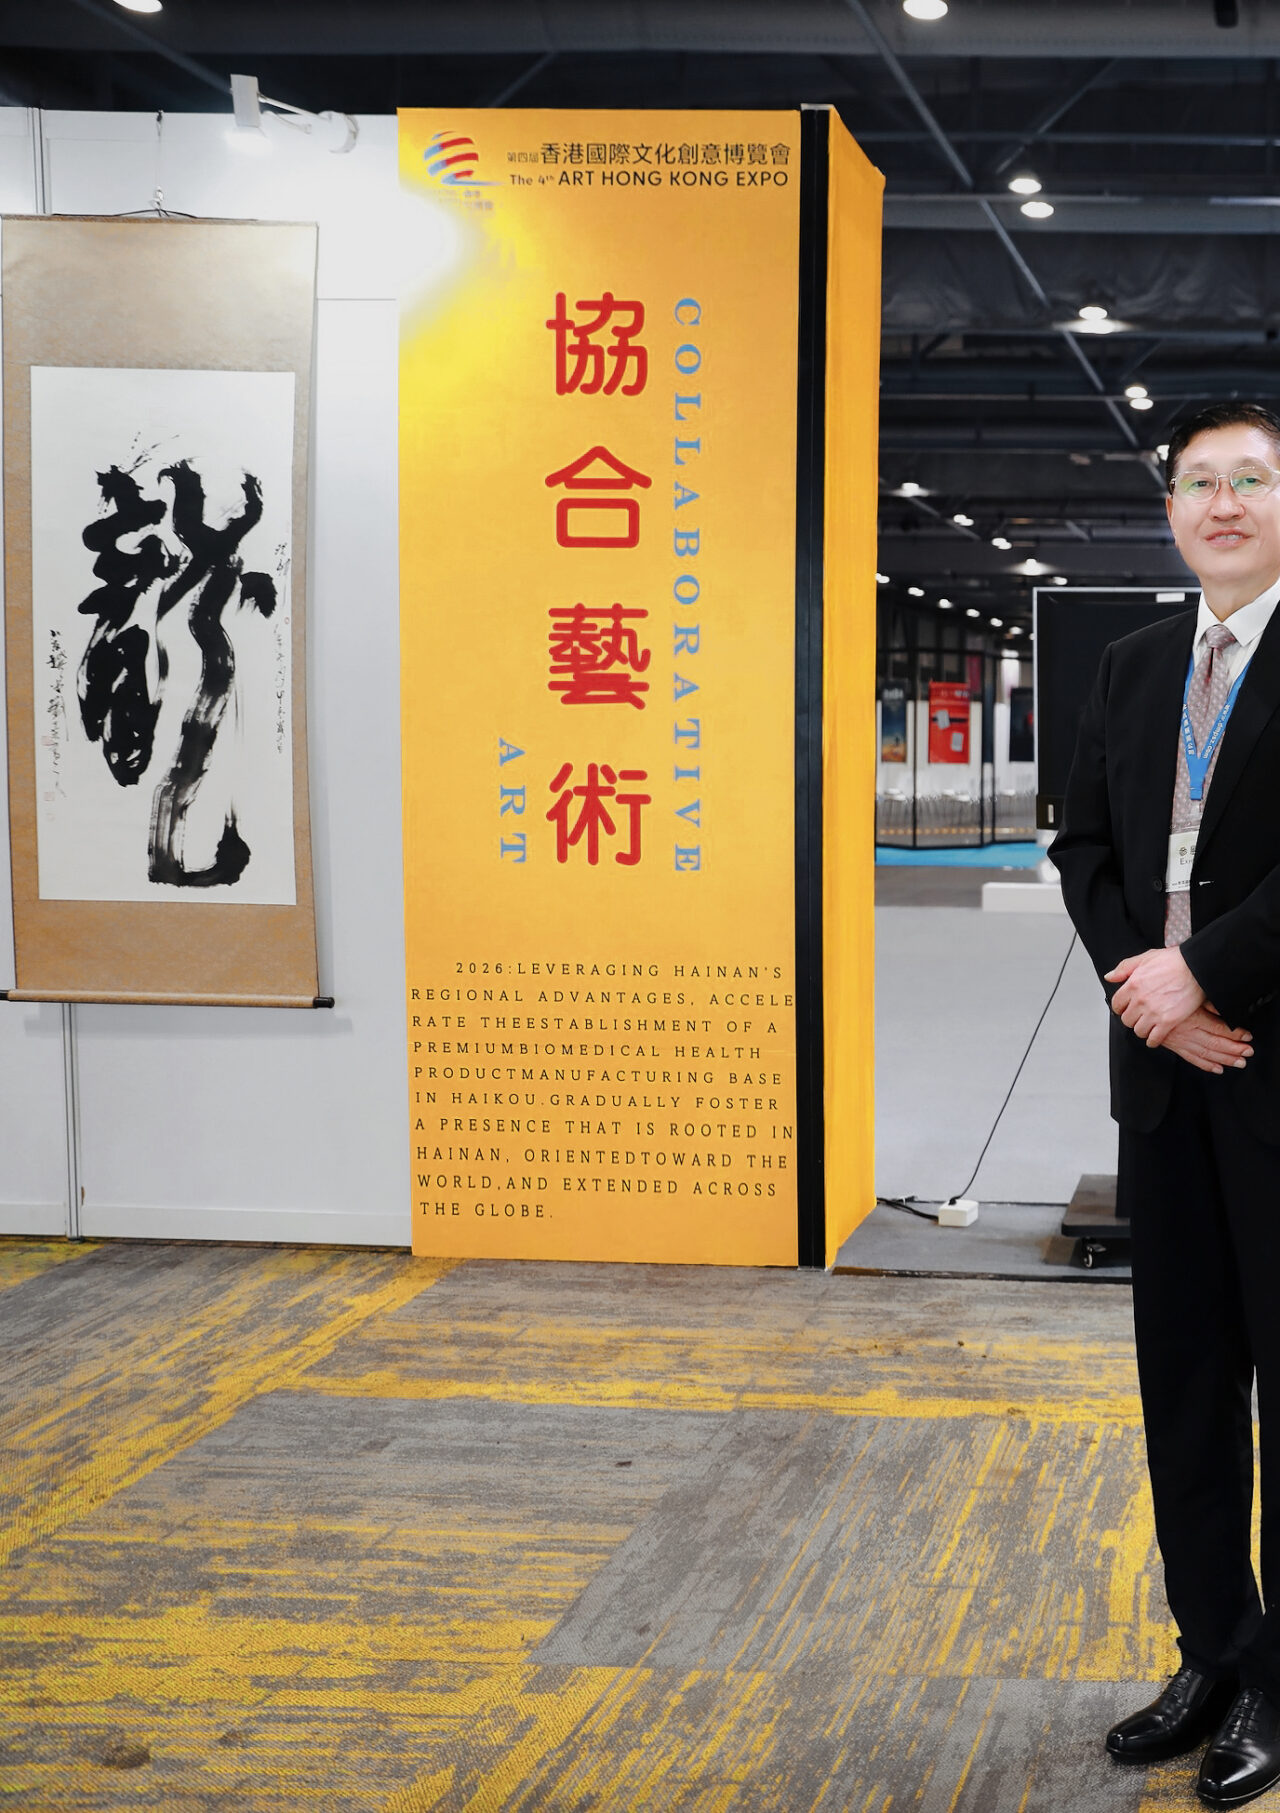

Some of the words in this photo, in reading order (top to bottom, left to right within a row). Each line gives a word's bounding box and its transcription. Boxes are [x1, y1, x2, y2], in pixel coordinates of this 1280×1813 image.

[510, 174, 533, 186] The
[558, 170, 594, 186] ART
[602, 170, 662, 187] HONG
[670, 171, 729, 187] KONG
[736, 171, 788, 187] EXPO
[545, 291, 652, 866] 協合藝術
[674, 297, 702, 872] COLLABORATIVE
[499, 737, 527, 864] ART
[674, 965, 782, 980] HAINAN'S
[411, 989, 524, 1002] REGIONAL
[710, 993, 794, 1007] ACCELE
[412, 1016, 466, 1028] RATE
[726, 1021, 753, 1033] OF
[766, 1022, 777, 1034] A
[674, 1046, 760, 1060] HEALTH
[729, 1073, 782, 1085] BASE
[415, 1092, 437, 1104] IN
[695, 1097, 779, 1111] FOSTER
[414, 1118, 426, 1131] A
[439, 1118, 551, 1134] PRESENCE
[564, 1121, 622, 1135] THAT
[636, 1122, 655, 1136] IS
[669, 1123, 757, 1139] ROOTED
[772, 1125, 793, 1140] IN
[416, 1147, 510, 1164] HAINAN,
[746, 1155, 787, 1170] THE
[562, 1178, 678, 1194] EXTENDED
[692, 1182, 776, 1197] ACROSS
[419, 1202, 461, 1216] THE
[474, 1203, 553, 1219] GLOBE.
